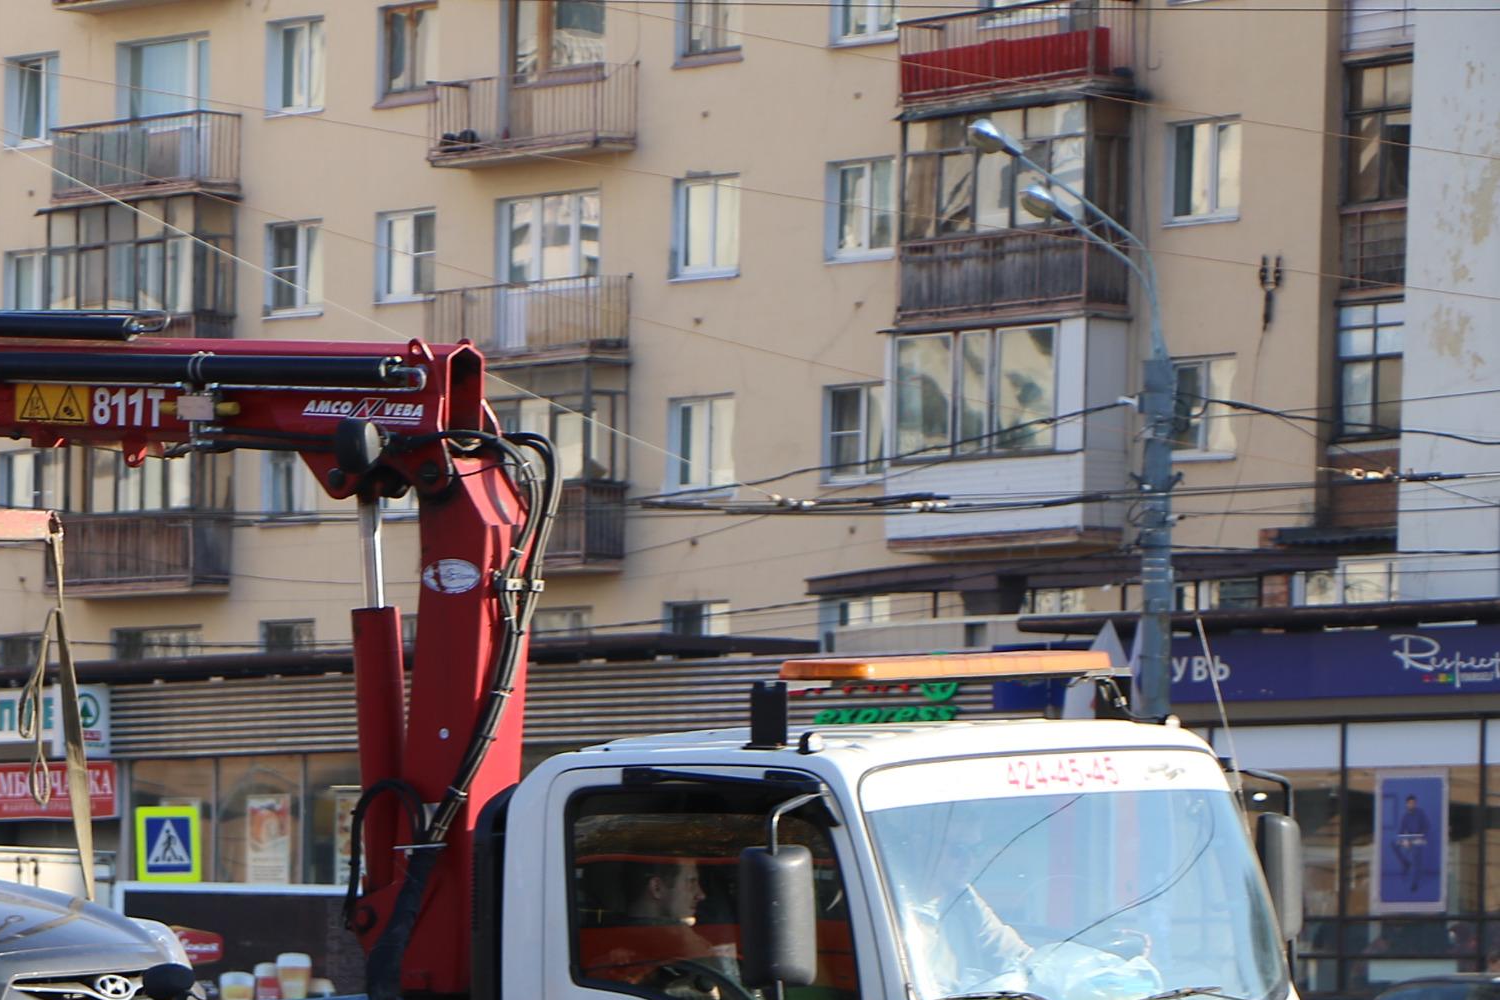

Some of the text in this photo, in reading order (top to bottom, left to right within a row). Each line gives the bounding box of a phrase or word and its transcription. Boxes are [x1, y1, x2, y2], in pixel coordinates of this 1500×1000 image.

[92, 387, 166, 427] 811T
[303, 400, 424, 418] AMCO VEBA
[1007, 757, 1120, 789] 424-45-45
